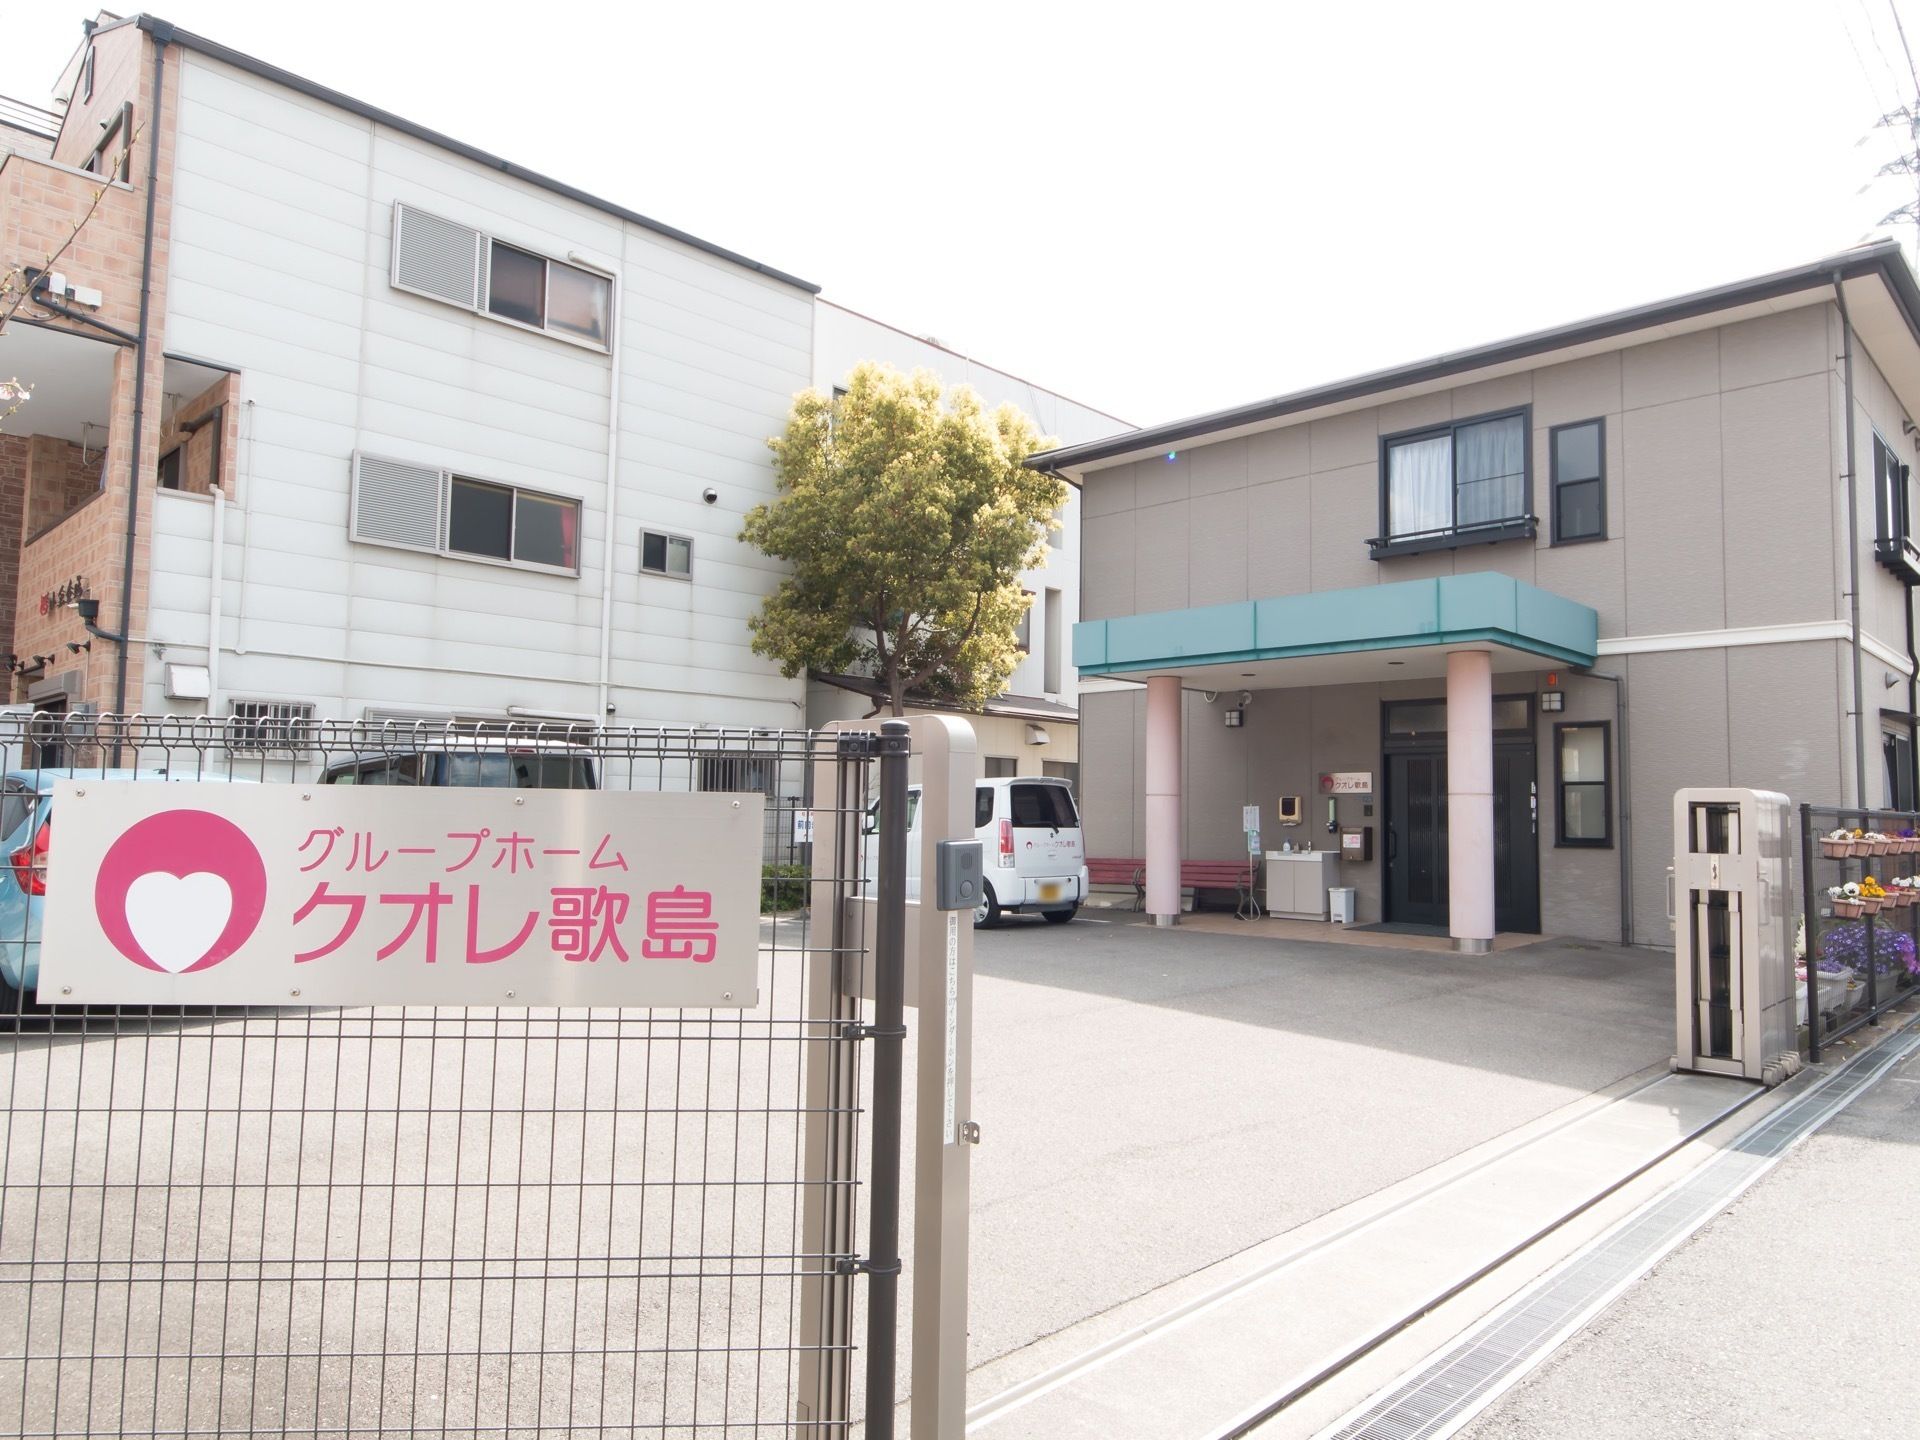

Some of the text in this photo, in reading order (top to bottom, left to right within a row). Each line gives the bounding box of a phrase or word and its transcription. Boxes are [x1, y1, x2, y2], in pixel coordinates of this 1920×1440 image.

[298, 826, 629, 874] グループホーム
[293, 881, 719, 964] クオレ歌島
